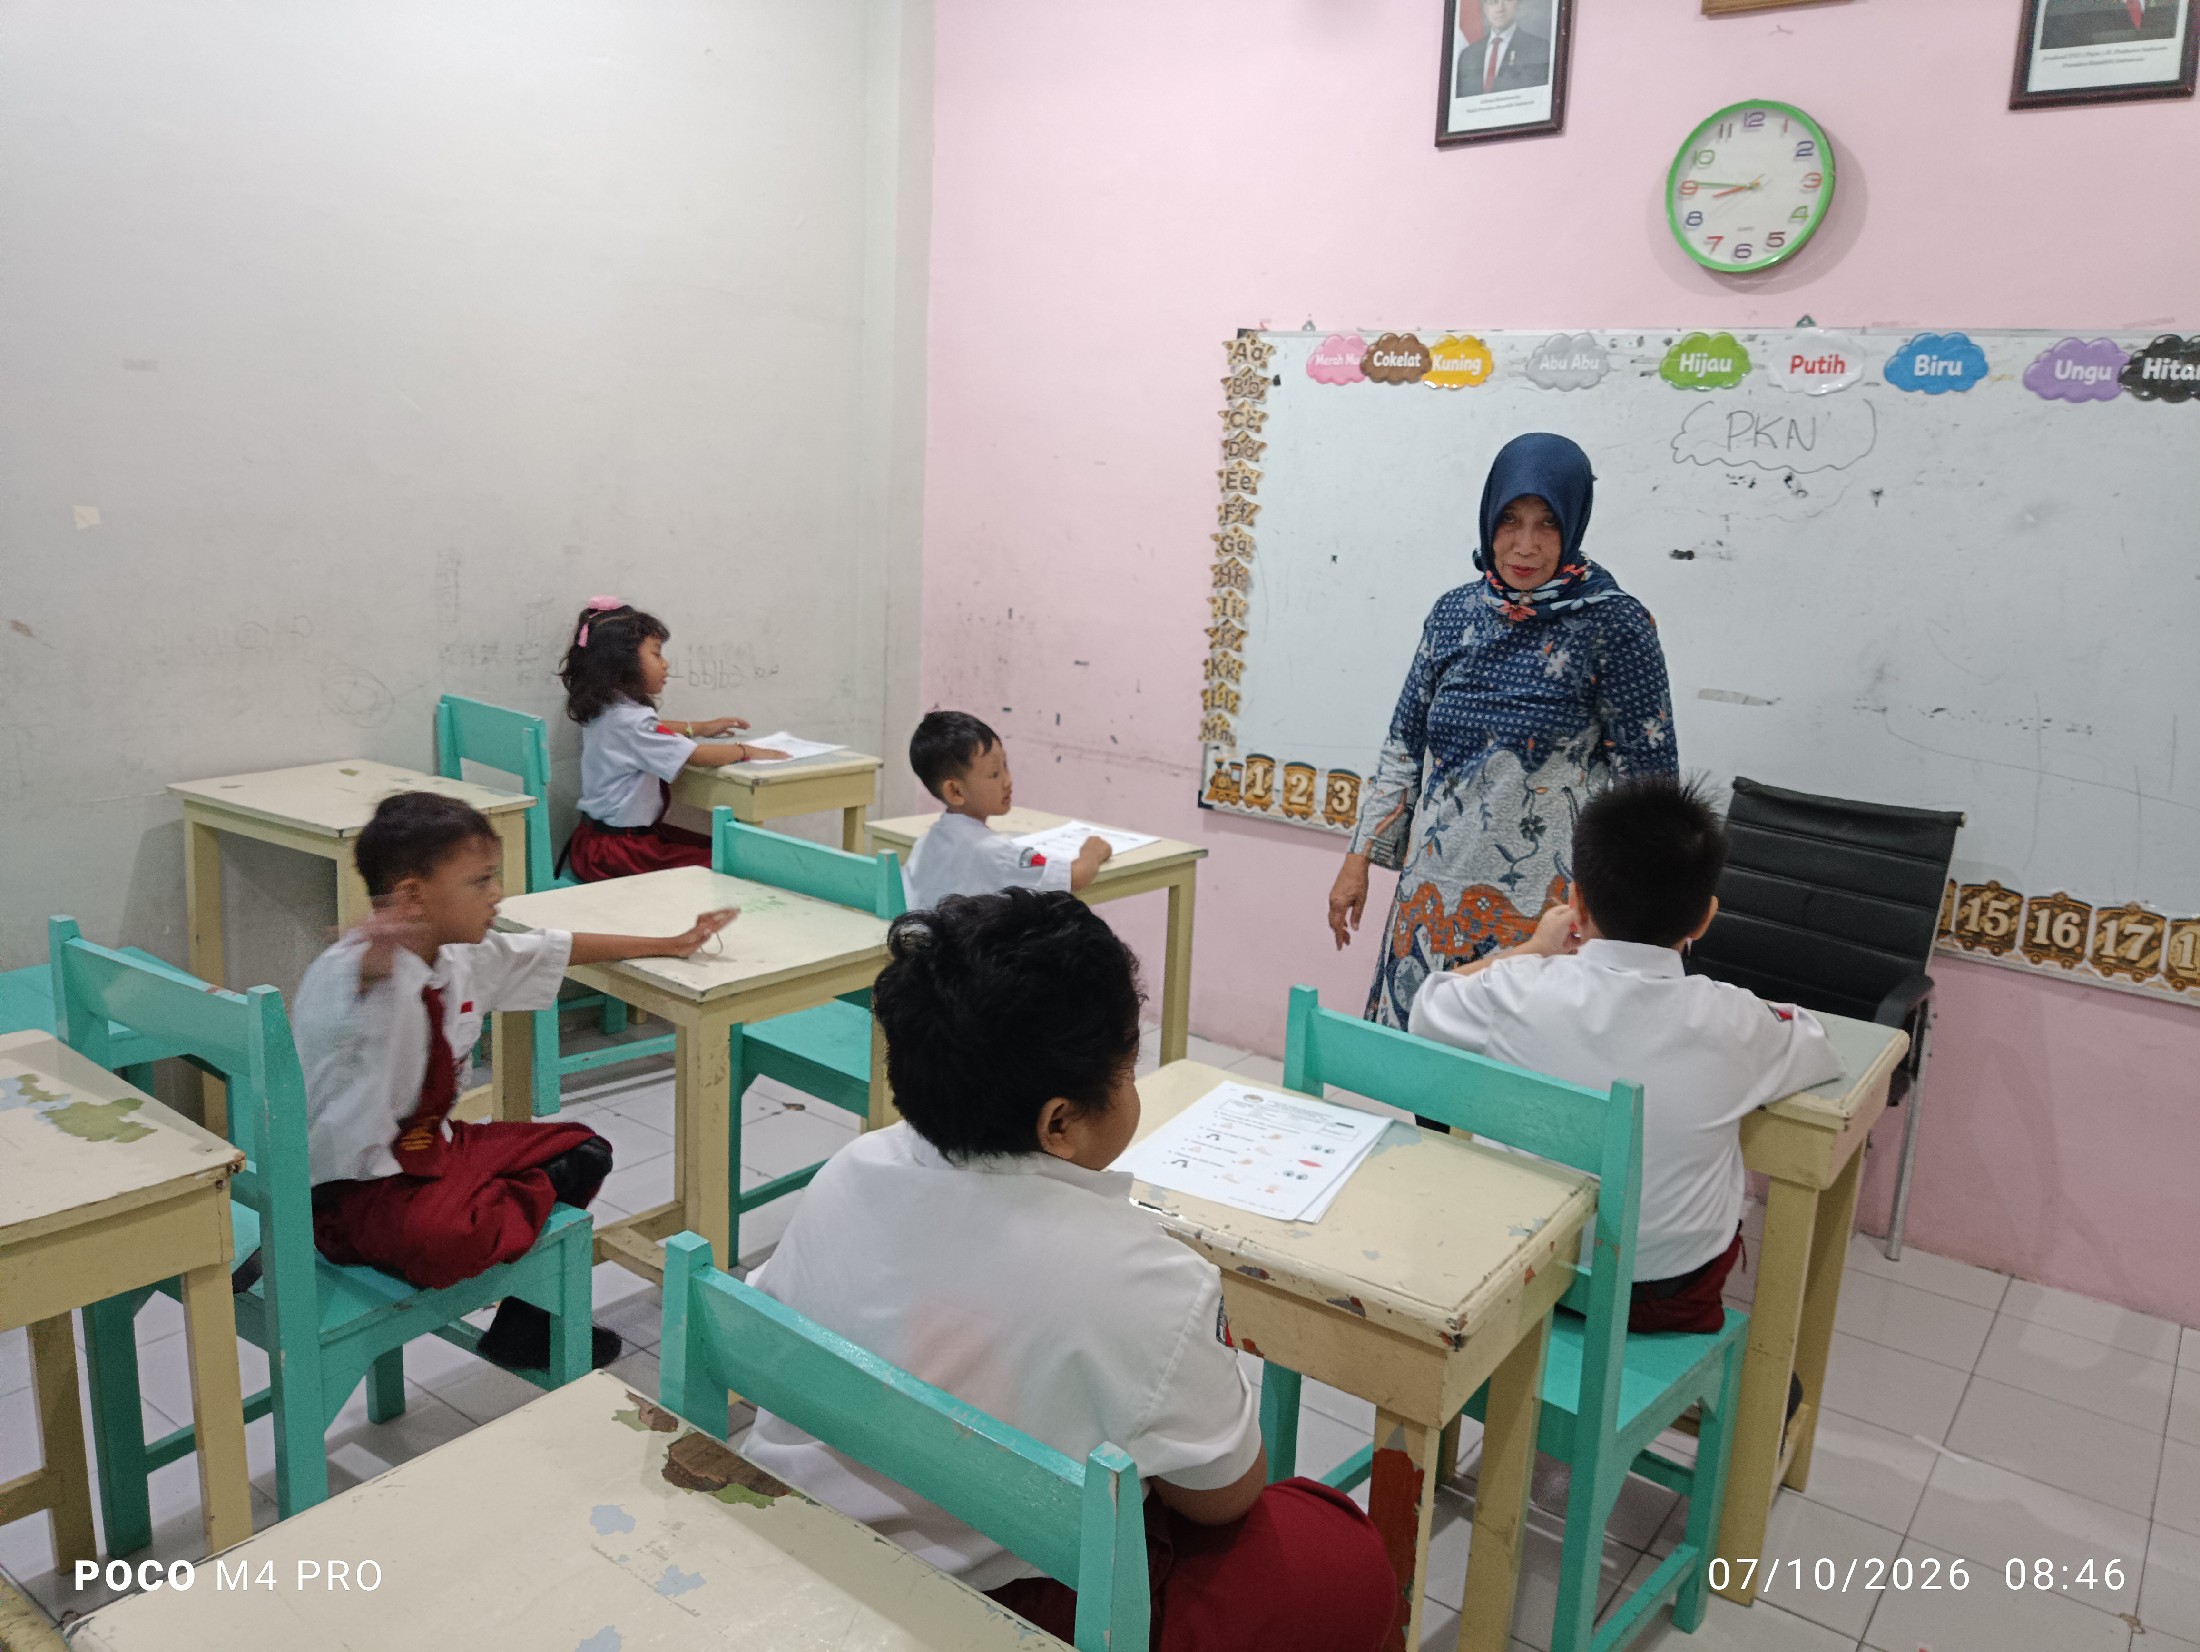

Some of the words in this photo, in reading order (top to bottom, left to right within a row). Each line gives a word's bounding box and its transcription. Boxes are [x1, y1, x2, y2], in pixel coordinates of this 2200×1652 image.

[1743, 111, 1766, 128] 12
[1783, 118, 1790, 133] 1
[1719, 123, 1733, 139] 11
[1692, 149, 1715, 165] 10
[1795, 140, 1815, 158] 2
[1679, 180, 1699, 196] 9
[1802, 172, 1822, 189] 3
[1686, 210, 1704, 227] 8
[1791, 205, 1809, 219] 4
[1706, 235, 1724, 251] 7
[1766, 231, 1785, 248] 5
[1734, 242, 1753, 259] 6
[1233, 342, 1263, 361] Aa
[1345, 352, 1361, 366] Mu
[1373, 350, 1422, 368] Cokelat
[1432, 353, 1482, 376] Kuning
[1539, 353, 1567, 371] Abu
[1570, 353, 1599, 371] Abu
[1679, 353, 1733, 379] Hijau
[1790, 353, 1846, 375] Putih
[1913, 353, 1963, 377] Biru
[2142, 357, 2200, 381] Hita
[2054, 359, 2113, 385] Ungu
[1229, 411, 1257, 429] Cc
[1726, 410, 1816, 452] PKN
[1225, 471, 1252, 490] Ee
[1220, 534, 1247, 555] Gg
[1252, 766, 1266, 797] 1
[1289, 773, 1308, 804] 2
[1331, 780, 1351, 812] 3
[1965, 897, 2011, 937] 15
[2032, 908, 2081, 949] 16
[2100, 919, 2155, 961] 17
[2179, 932, 2198, 970] 1
